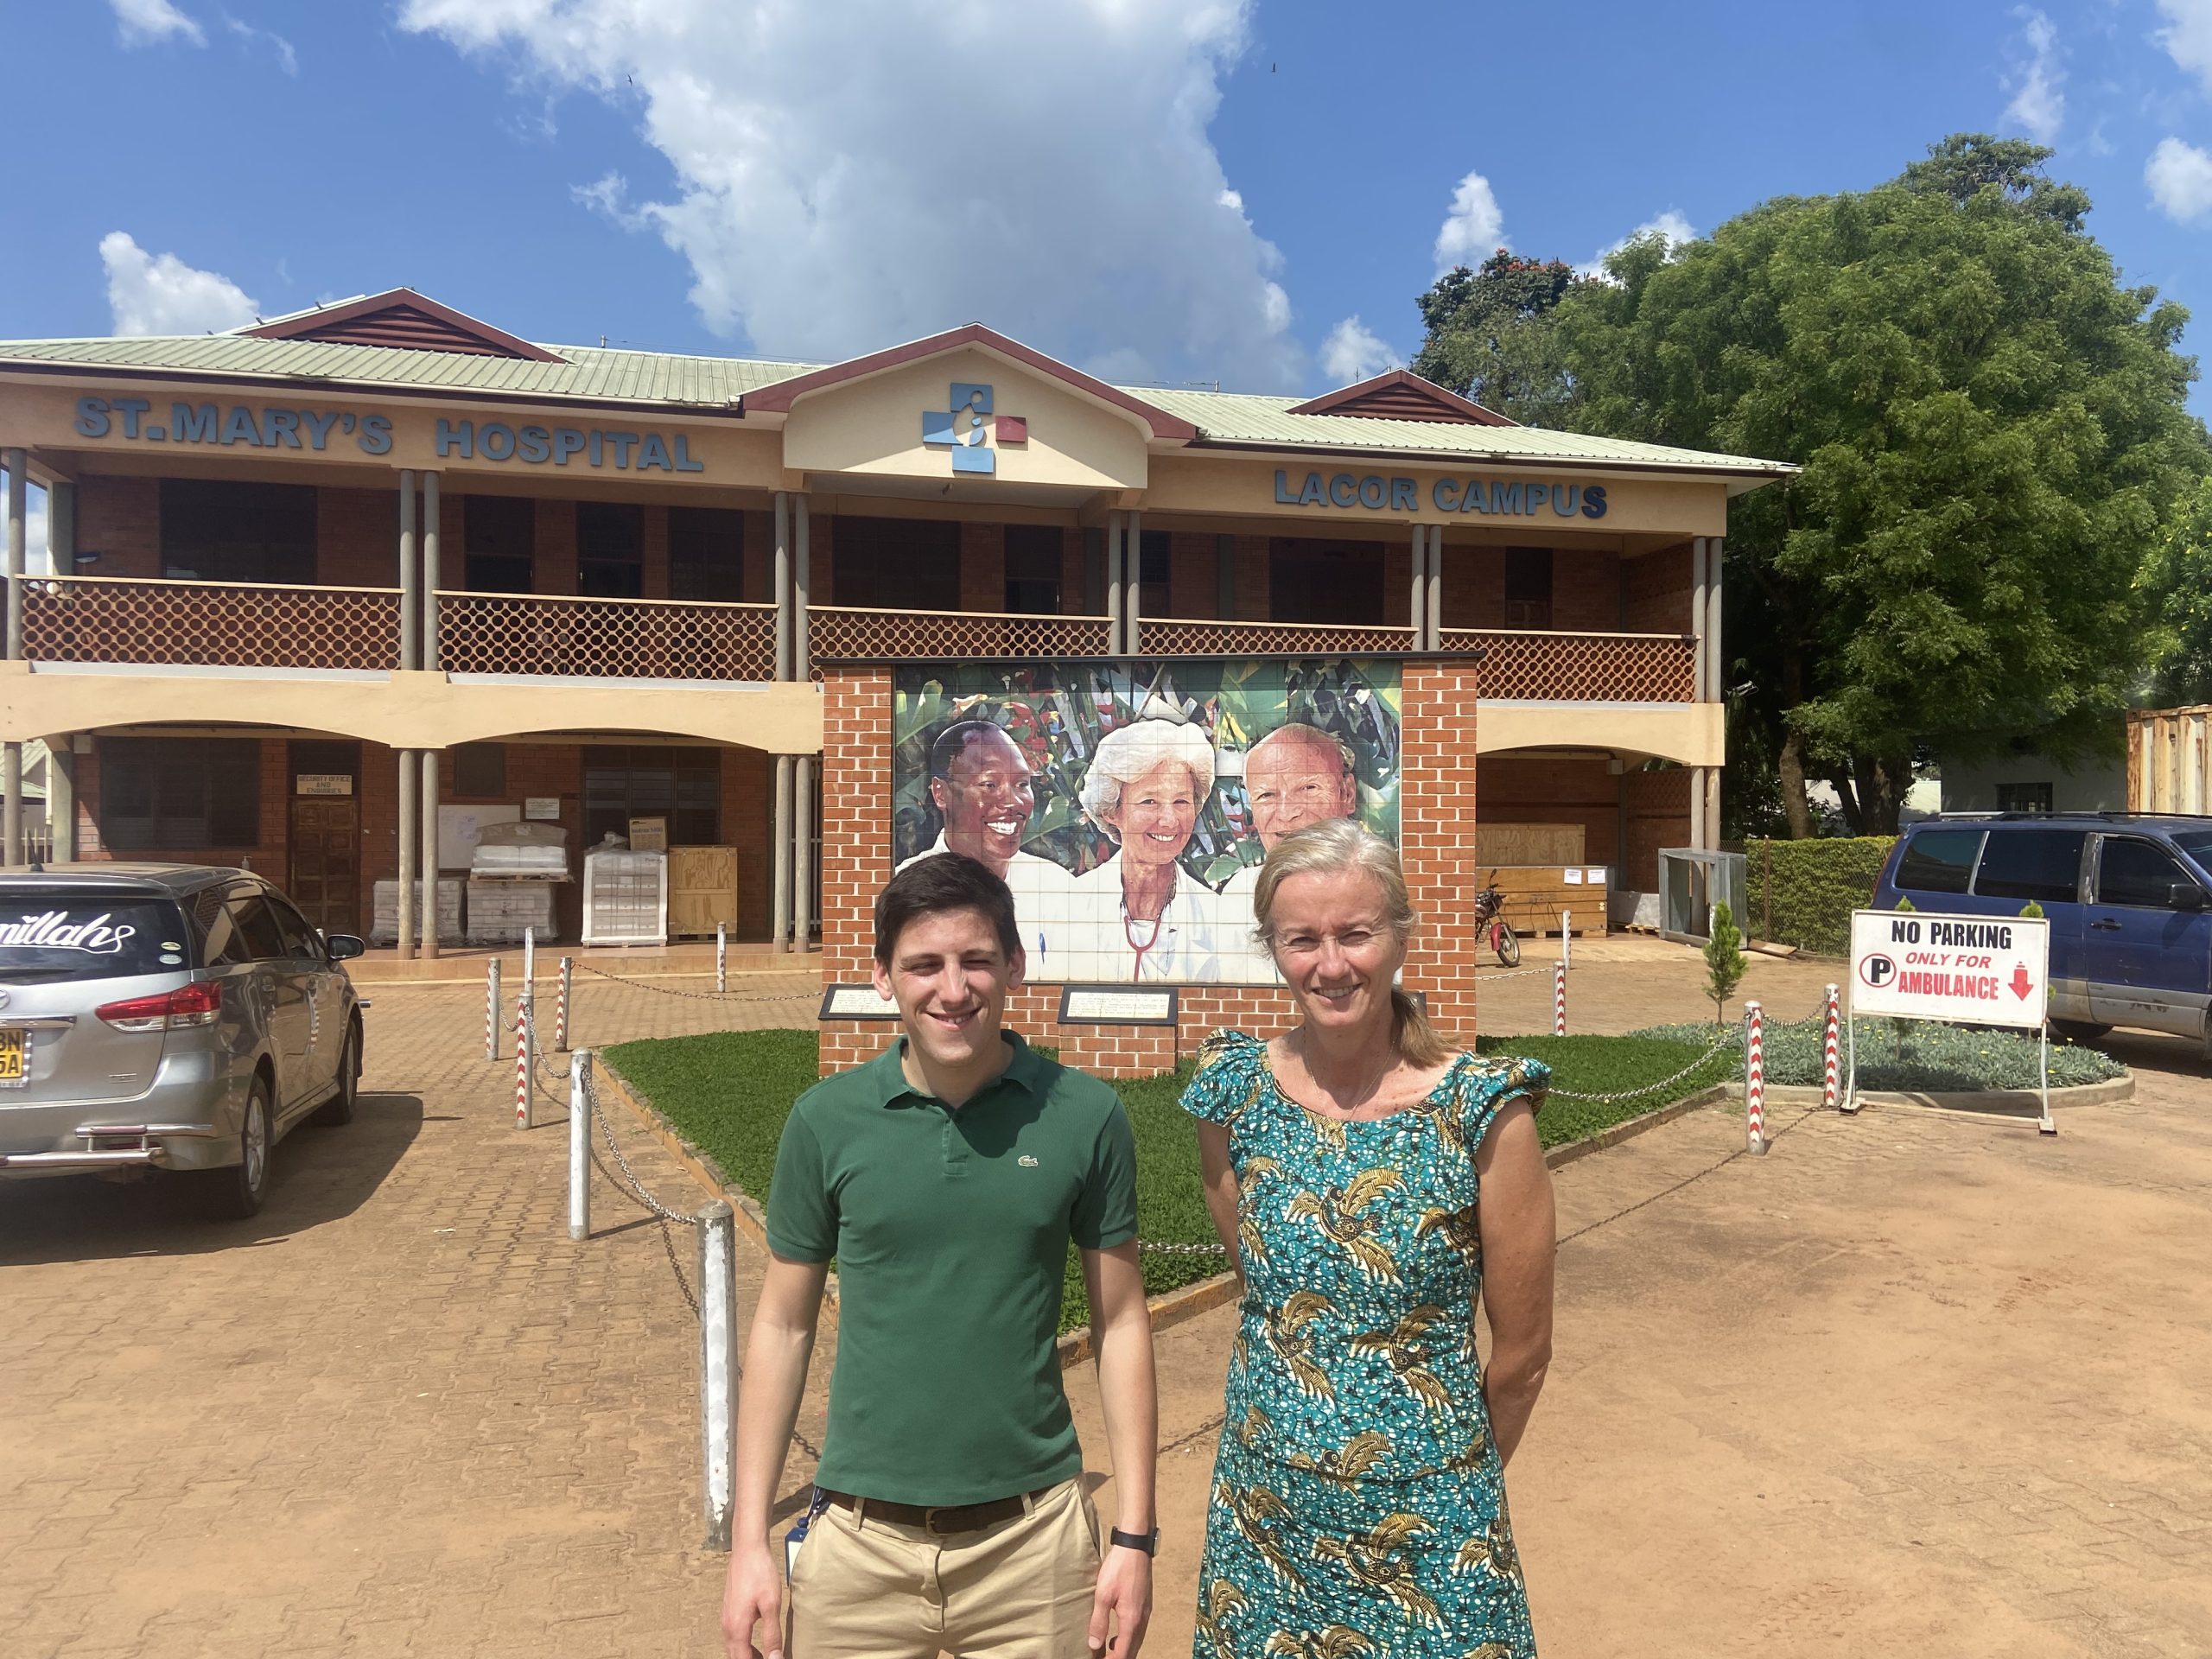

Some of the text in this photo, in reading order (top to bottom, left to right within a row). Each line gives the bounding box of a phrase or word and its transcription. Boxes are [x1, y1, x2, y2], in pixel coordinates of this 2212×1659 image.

[435, 418, 704, 472] HOSPITAL
[1274, 469, 1608, 518] LACOR CAMPUS
[1891, 920, 2012, 950] NO PARKING
[1871, 958, 1891, 983] P
[1905, 952, 1992, 969] ONLY FOR
[1897, 971, 1999, 1000] AMBULANCE
